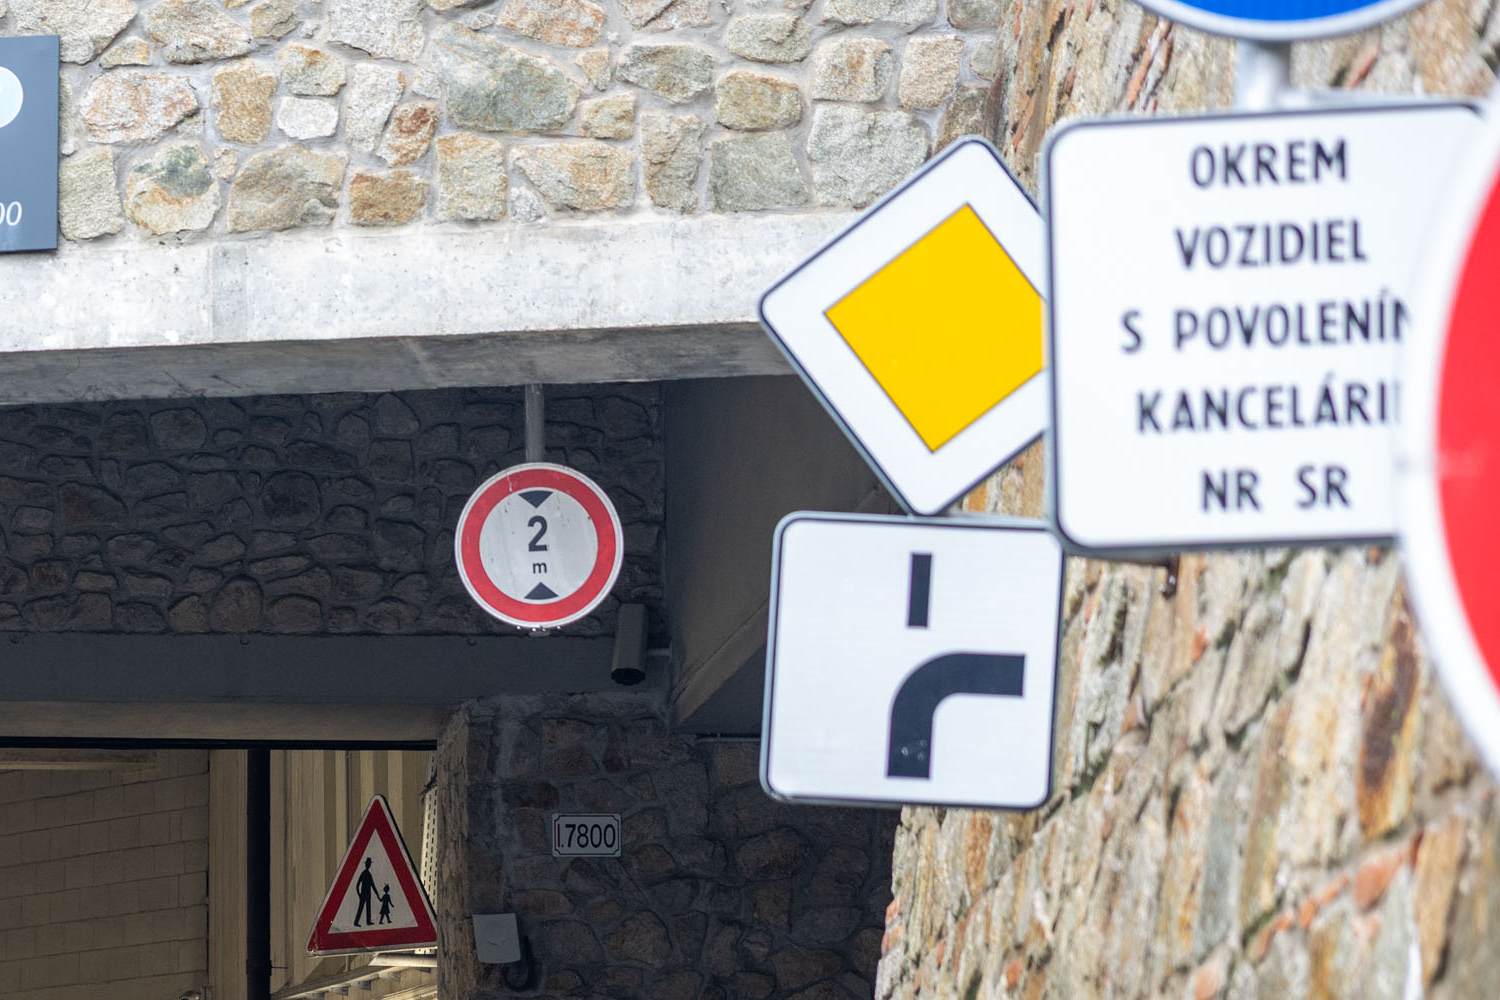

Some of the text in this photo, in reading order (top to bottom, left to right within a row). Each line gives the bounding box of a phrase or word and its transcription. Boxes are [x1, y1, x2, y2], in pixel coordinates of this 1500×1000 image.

[1190, 138, 1347, 189] OKREM
[1174, 219, 1368, 270] VOZIDIEL
[1121, 309, 1142, 354] S
[1136, 372, 1400, 434] KANCELÁRI
[1201, 465, 1351, 512] NR SR
[527, 515, 548, 552] 2
[532, 562, 547, 574] m
